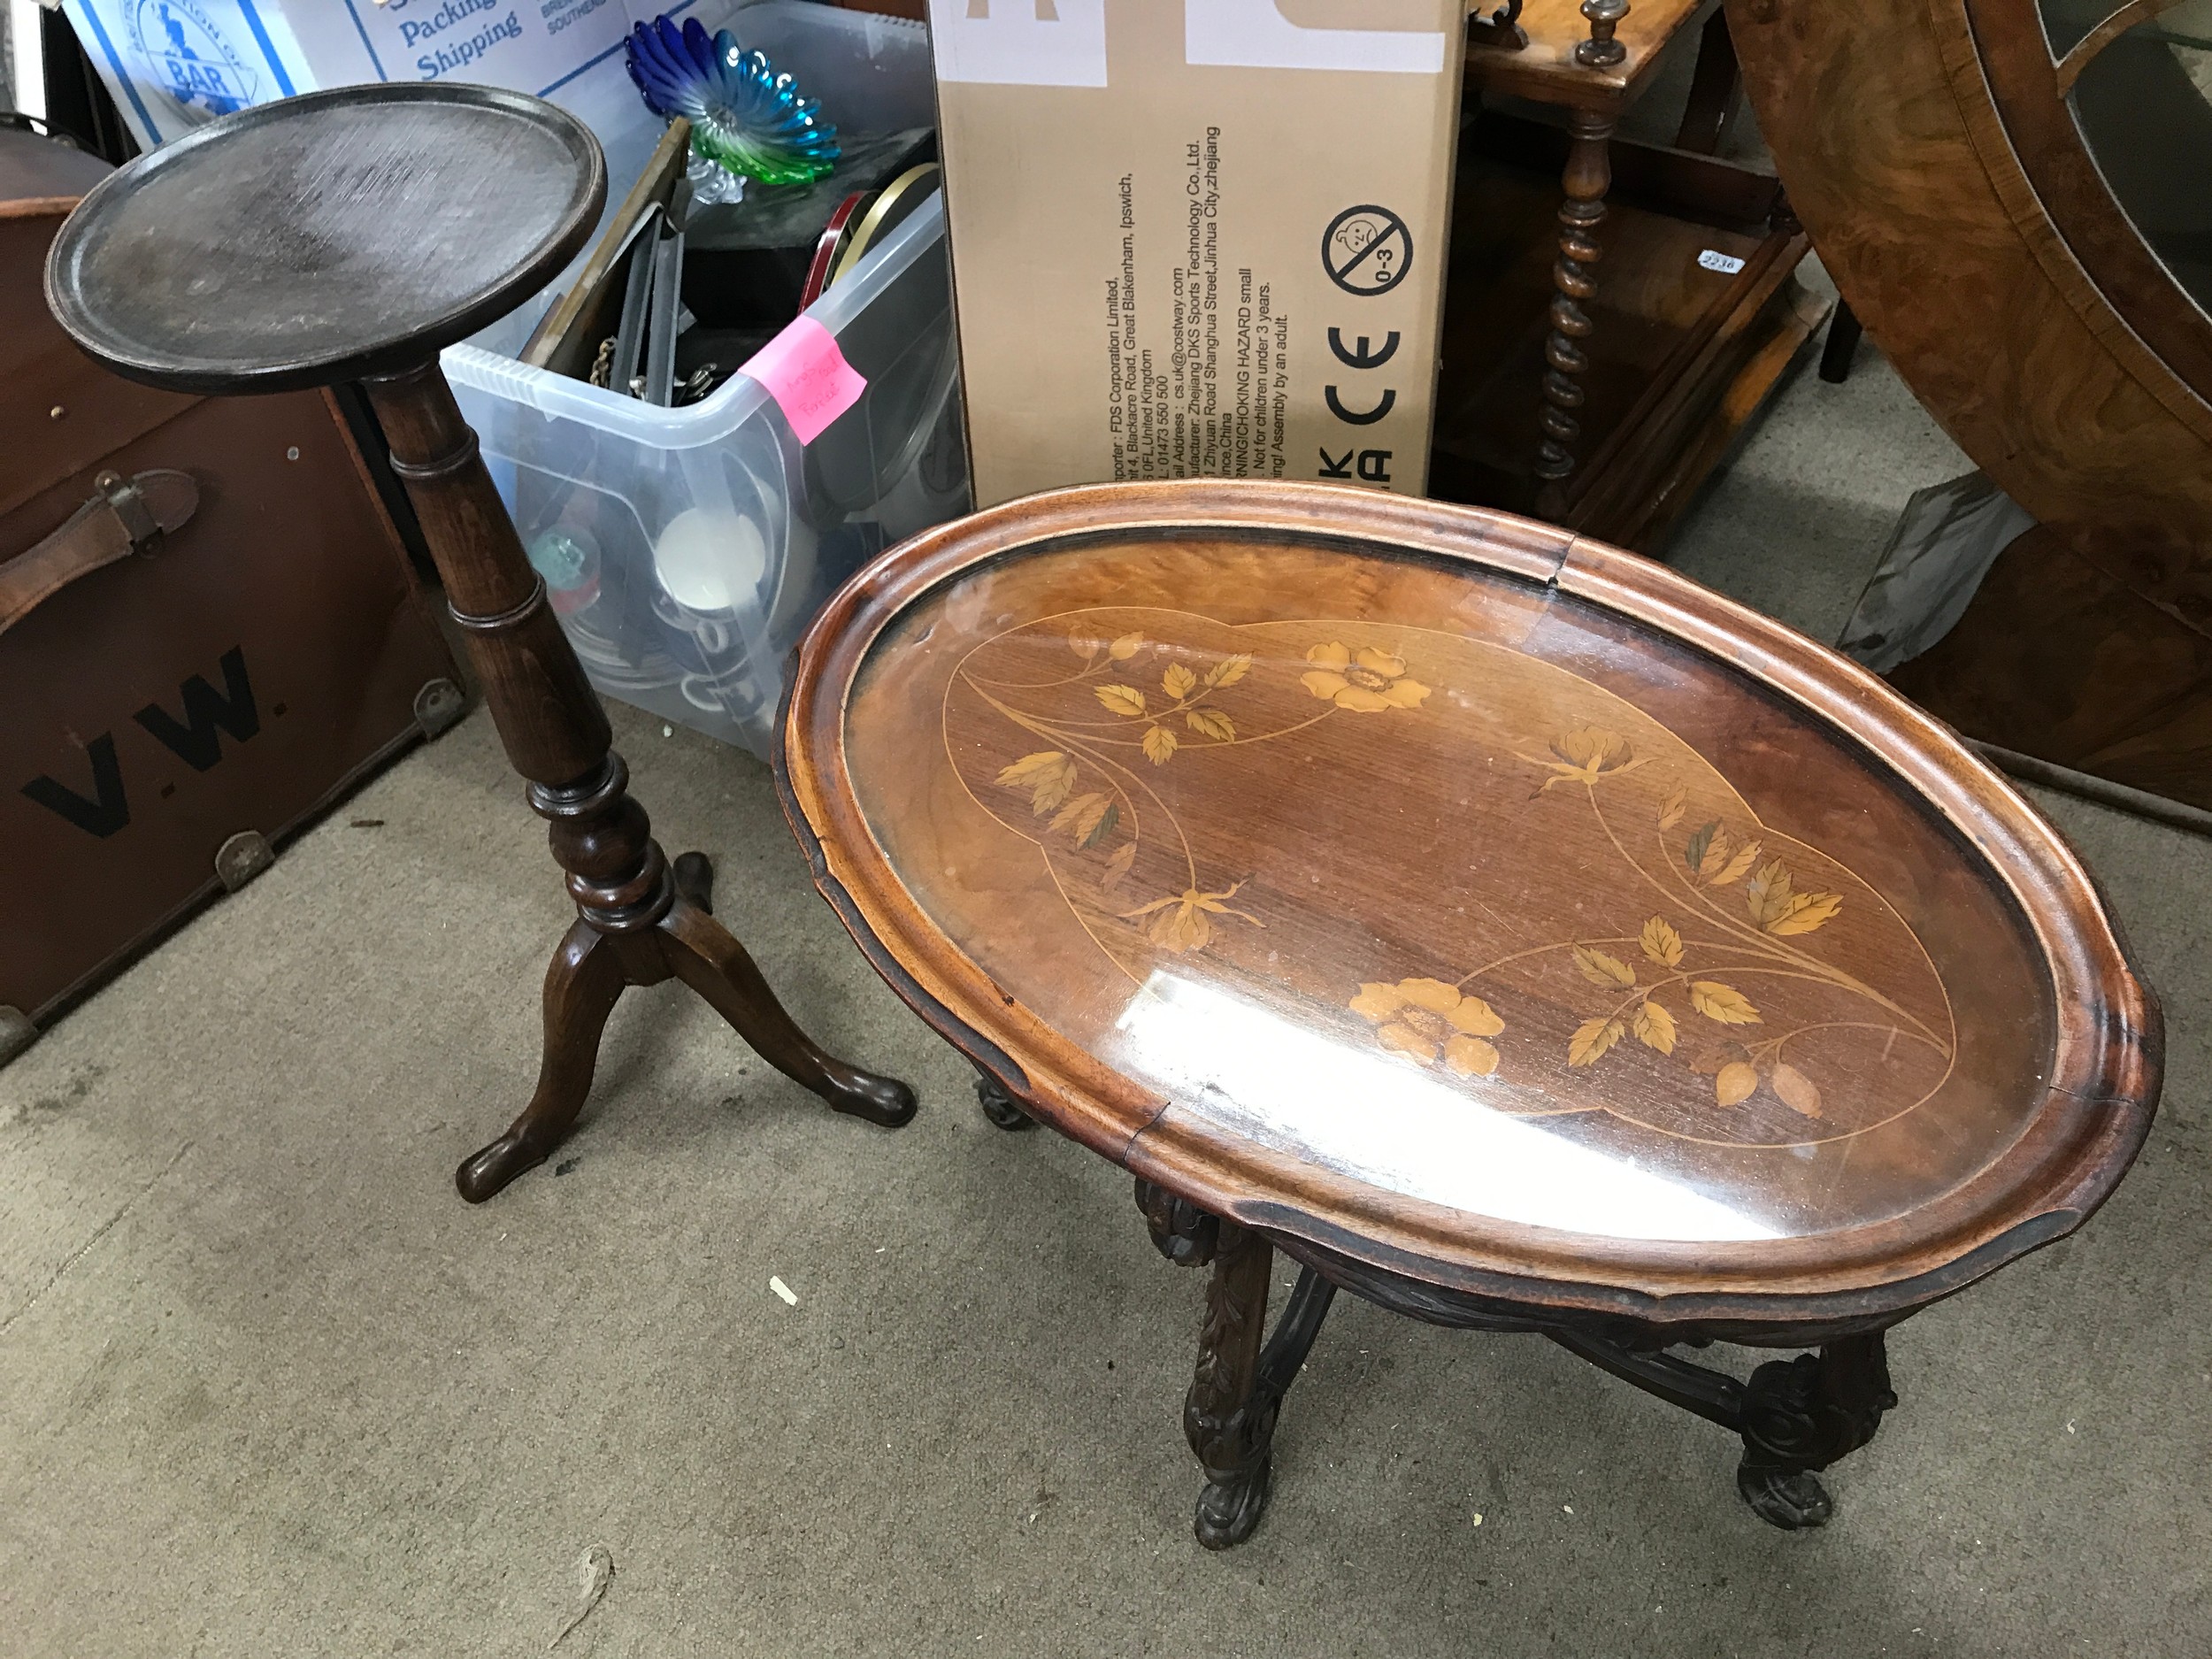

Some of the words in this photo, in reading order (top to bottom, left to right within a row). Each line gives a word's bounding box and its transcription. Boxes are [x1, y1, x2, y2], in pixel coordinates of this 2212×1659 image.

[417, 11, 522, 81] Shipping
[165, 58, 232, 95] BAR
[1187, 140, 1202, 196] Co.,Ltd.
[1118, 173, 1135, 228] Ipswich,
[1187, 200, 1202, 278] Technology
[1121, 234, 1134, 311] Blakenham,
[1239, 268, 1251, 303] small
[1375, 249, 1393, 284] 0-3
[1105, 277, 1120, 326] Limited,
[1187, 283, 1202, 325] Sports
[1258, 281, 1271, 321] years.
[1124, 315, 1135, 350] Great
[1171, 268, 1187, 399] cs.uk@costway.com
[1187, 329, 1201, 358] DKS
[1204, 314, 1219, 379] Shanghua
[1237, 307, 1250, 367] HAZARD
[1275, 314, 1288, 349] adult.
[1109, 331, 1122, 403] Corporation
[1125, 355, 1137, 390] Road,
[1256, 337, 1269, 374] under
[1275, 353, 1286, 369] an
[1140, 349, 1154, 403] Kingdom
[1156, 376, 1168, 399] 500
[1187, 362, 1203, 415] Zhejiang
[1273, 373, 1288, 388] by
[1156, 403, 1168, 425] 550
[1204, 383, 1217, 416] Road
[1254, 379, 1267, 426] children
[1110, 406, 1123, 433] FDS
[1126, 395, 1139, 452] Blackacre
[1173, 413, 1185, 462] Address
[1254, 429, 1265, 445] for
[1271, 391, 1288, 451] Assembly
[1128, 457, 1140, 466] 4,
[1157, 428, 1169, 465] 01473
[1204, 419, 1218, 466] Zhiyuan
[1219, 413, 1233, 477] ince,China
[1253, 449, 1265, 469] Not
[1173, 465, 1185, 478] ail
[1318, 446, 1354, 479] K
